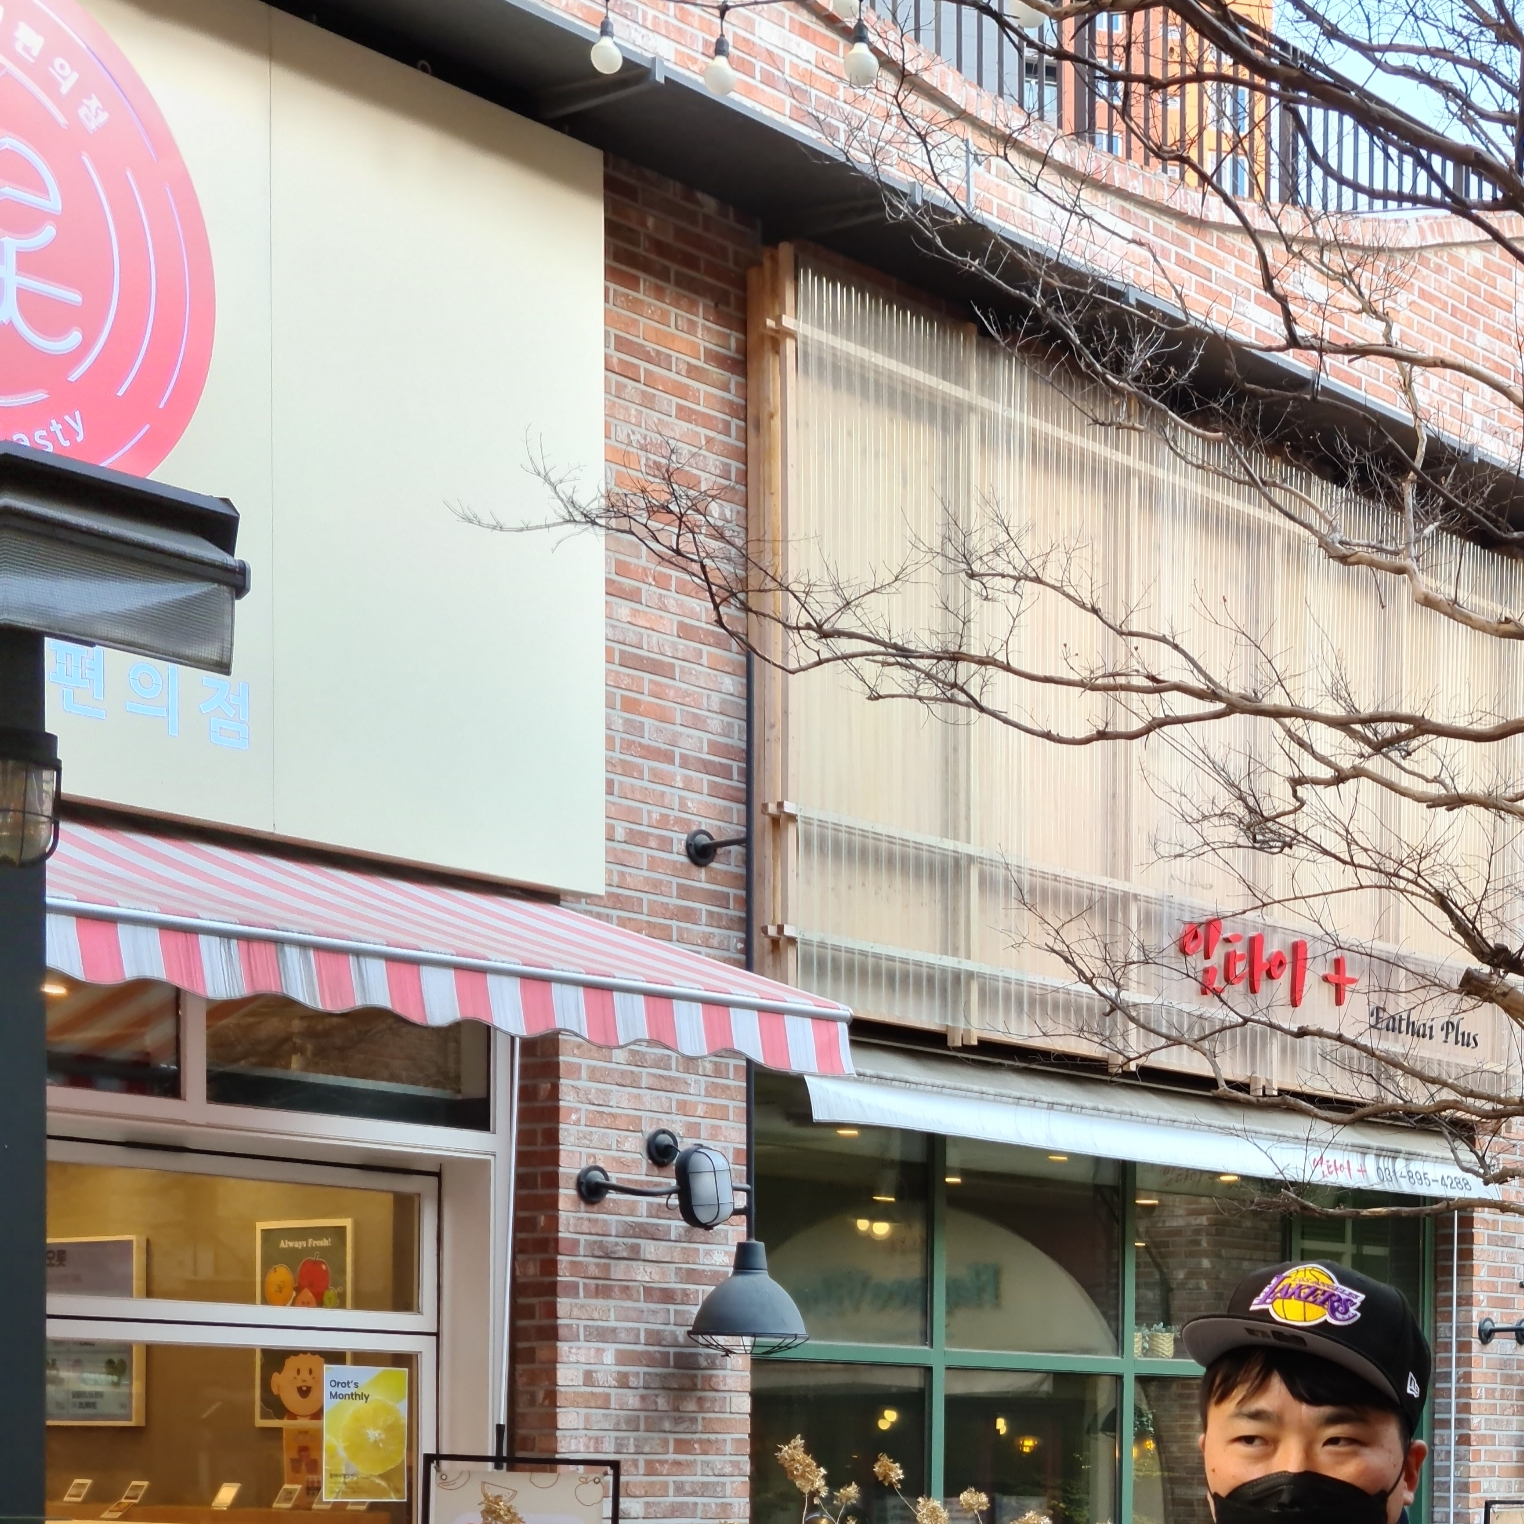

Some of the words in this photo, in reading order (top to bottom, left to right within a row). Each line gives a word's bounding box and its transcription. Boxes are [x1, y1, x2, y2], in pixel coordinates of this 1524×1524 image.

[0, 22, 110, 134] 편의점
[49, 638, 249, 750] 편의점
[1370, 1005, 1435, 1041] Eathai
[1441, 1017, 1479, 1049] Plus
[1376, 1165, 1472, 1192] 031-895-4288
[279, 1239, 306, 1249] Always
[308, 1237, 332, 1247] Fresh!
[1256, 1274, 1358, 1321] LAKERS
[329, 1391, 370, 1404] Monthly
